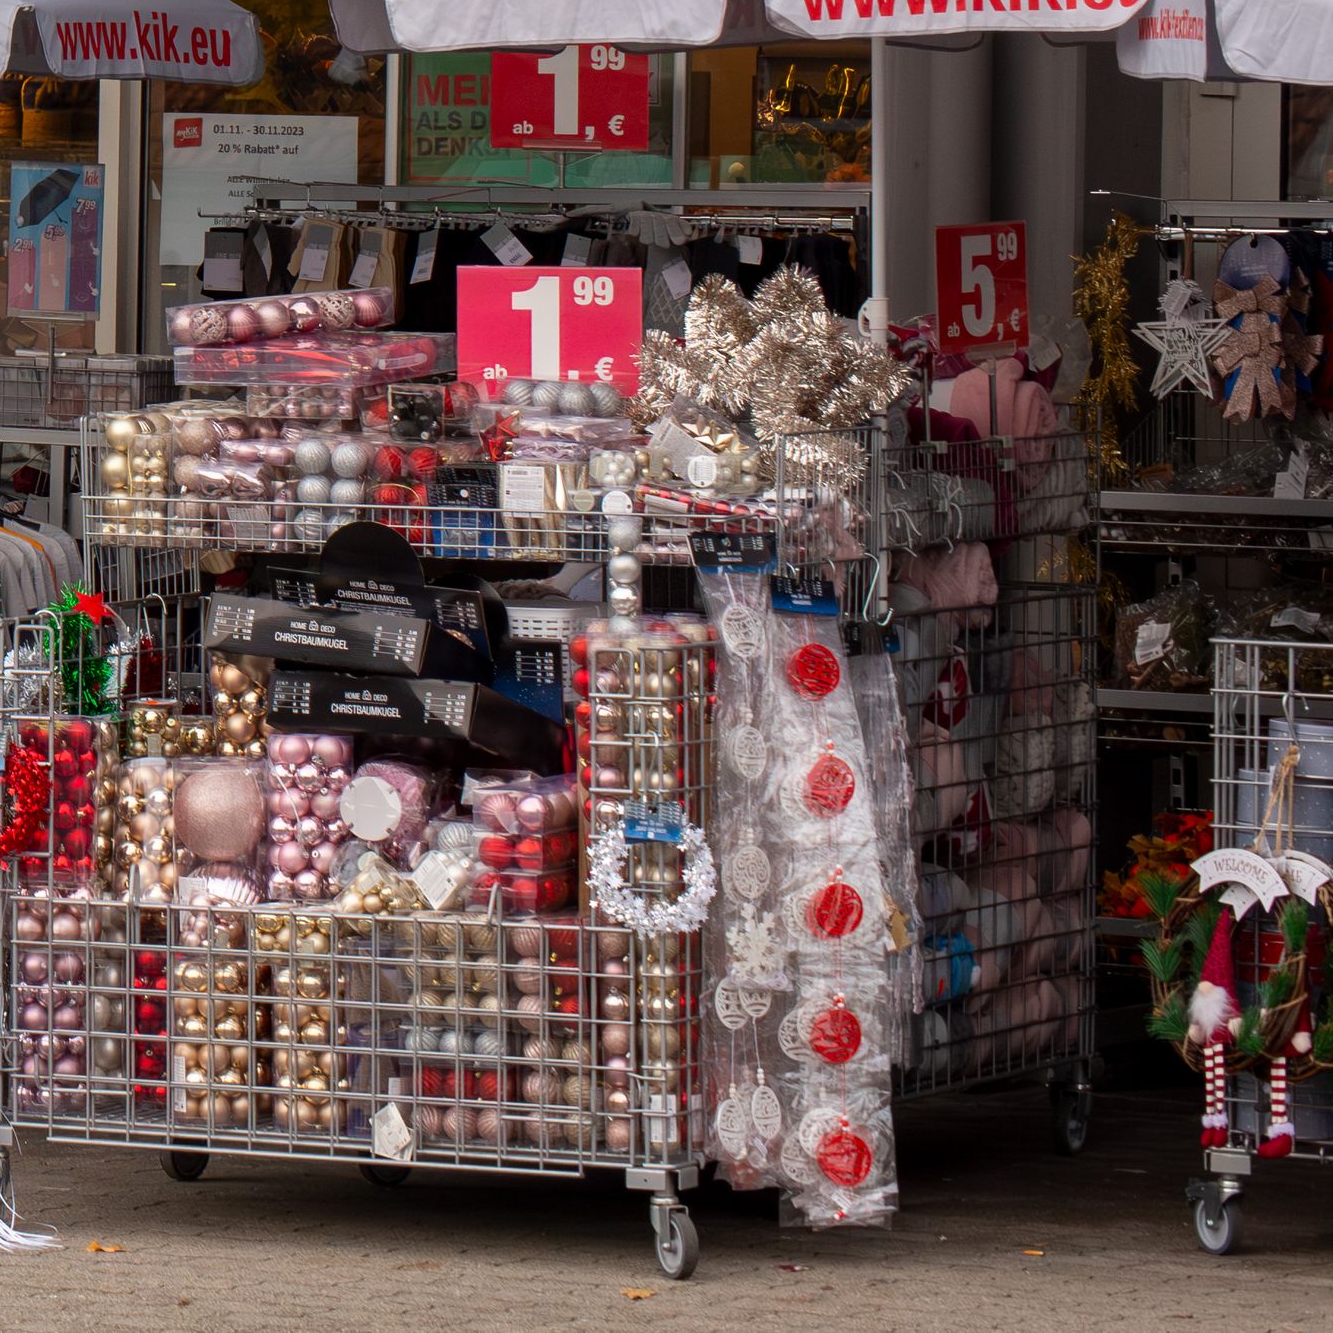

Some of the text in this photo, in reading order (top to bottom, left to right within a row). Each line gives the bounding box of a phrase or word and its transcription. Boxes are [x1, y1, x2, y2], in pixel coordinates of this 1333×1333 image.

[55, 10, 232, 68] www.kik.eu
[417, 74, 491, 107] ME
[213, 124, 243, 134] 01.11.
[253, 125, 304, 136] 30.11.2023
[416, 112, 462, 131] ALS
[511, 120, 535, 135] ab
[607, 114, 626, 137] €
[218, 144, 230, 153] 20
[233, 144, 242, 154] %
[282, 145, 300, 155] auf
[416, 137, 511, 156] DENK
[228, 190, 245, 198] ALLE
[946, 322, 961, 338] ab
[482, 363, 508, 380] ab
[594, 356, 614, 381] €
[349, 580, 366, 589] HOME
[337, 589, 412, 606] CHRISTBAUMKUGEL
[290, 621, 336, 634] HOME DECO
[274, 631, 349, 651] CHRISTBAUMKUGEL
[344, 692, 388, 703] HOME DECO
[330, 702, 402, 719] CHRISTBAUMKUGEL
[1213, 857, 1269, 885] WELCOME
